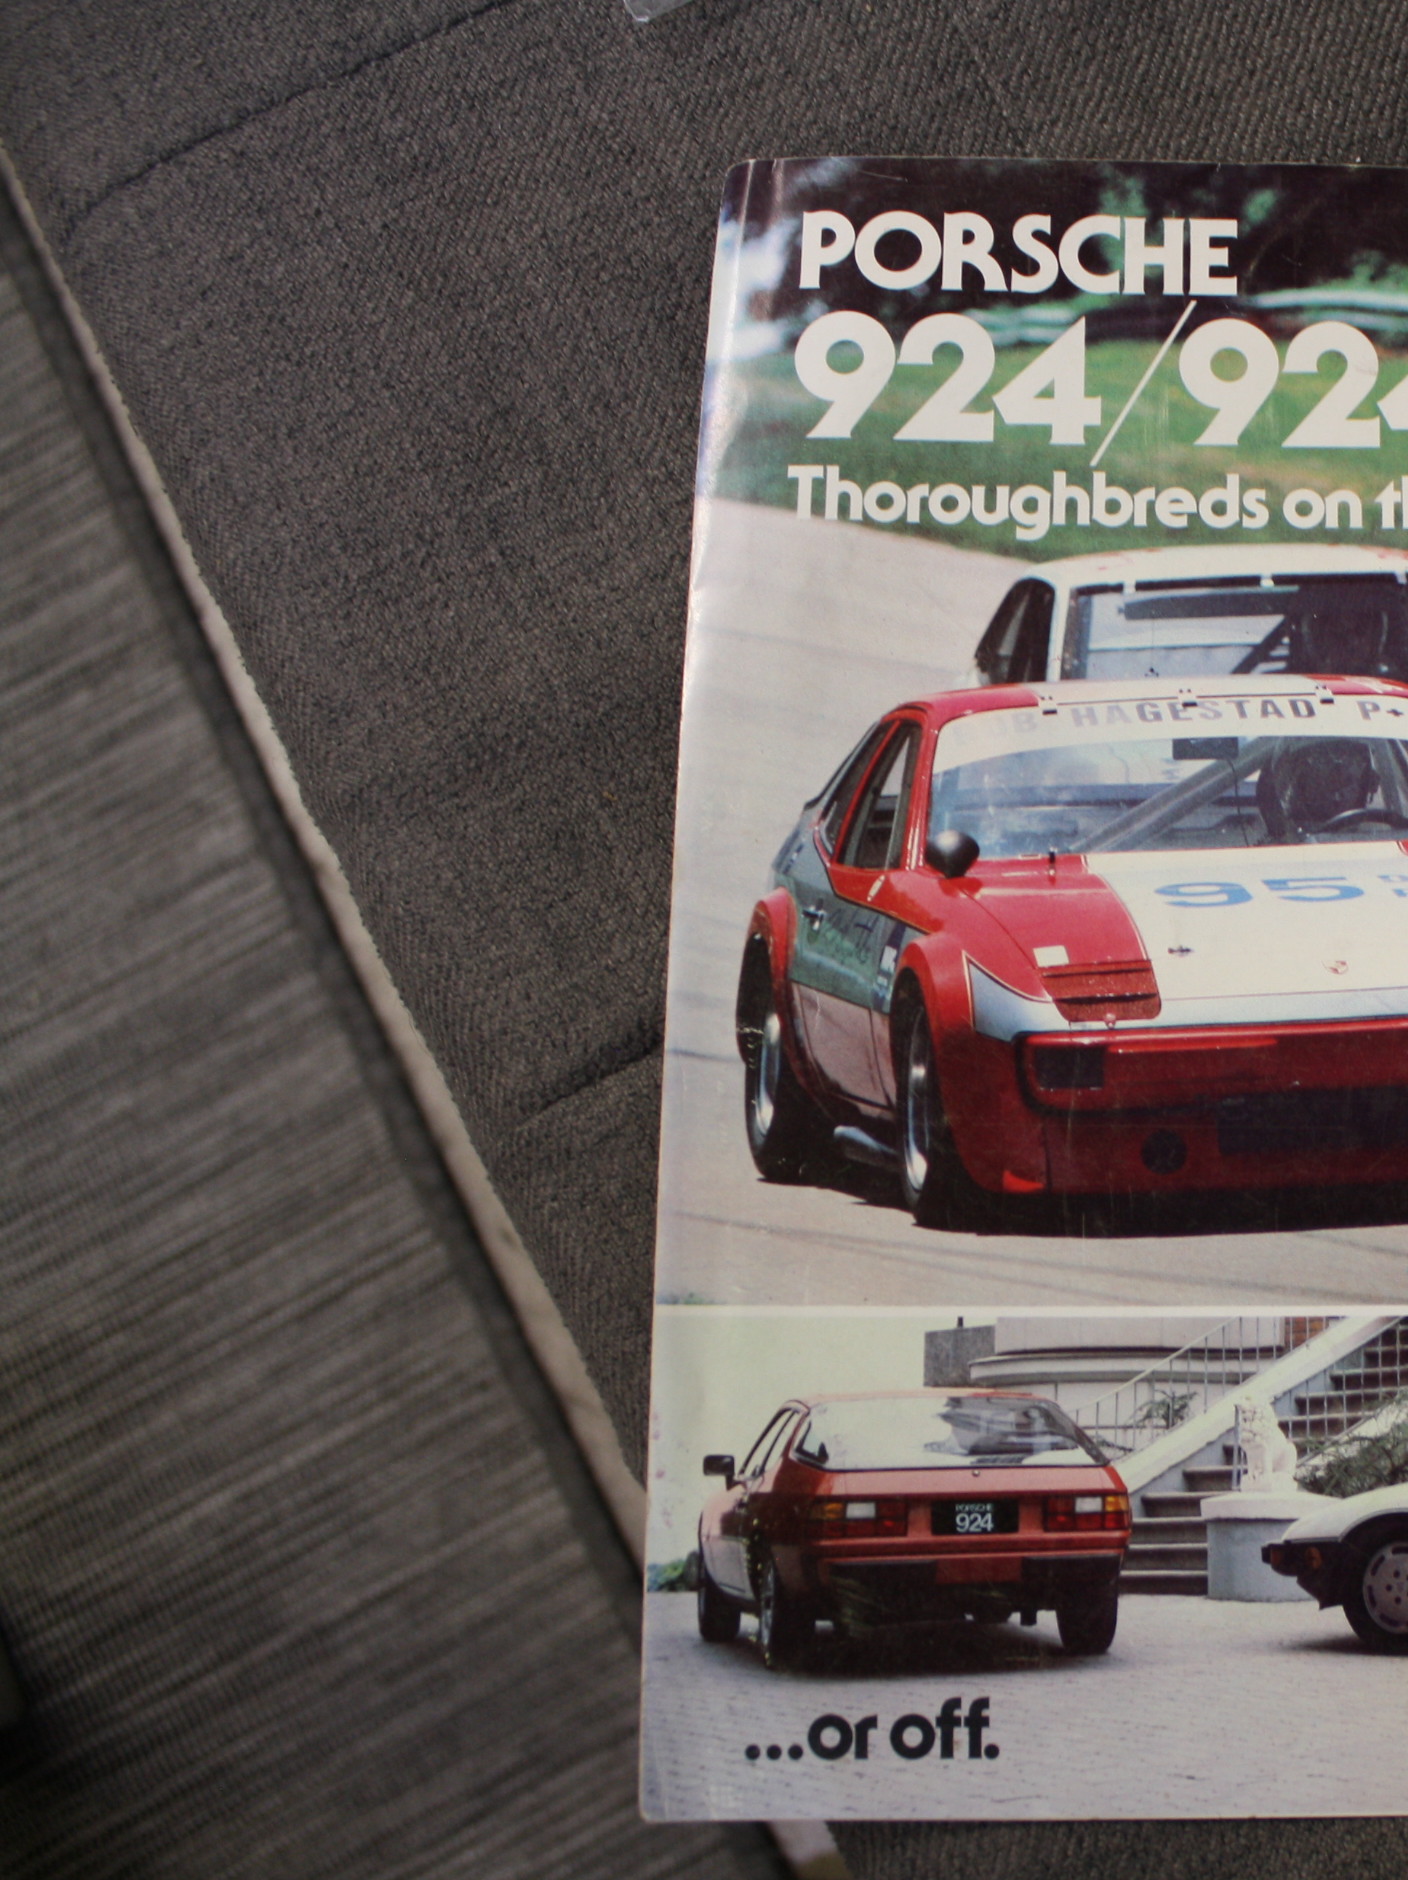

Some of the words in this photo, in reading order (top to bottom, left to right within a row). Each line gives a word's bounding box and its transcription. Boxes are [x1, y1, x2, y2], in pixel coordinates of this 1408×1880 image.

[799, 209, 1239, 297] PORSCHE
[786, 464, 1267, 541] Thoroughbreds
[1281, 487, 1364, 531] on
[1070, 698, 1317, 729] HAGESTAD
[1153, 875, 1365, 909] 95
[955, 1512, 994, 1533] 924
[889, 1696, 1000, 1761] off.
